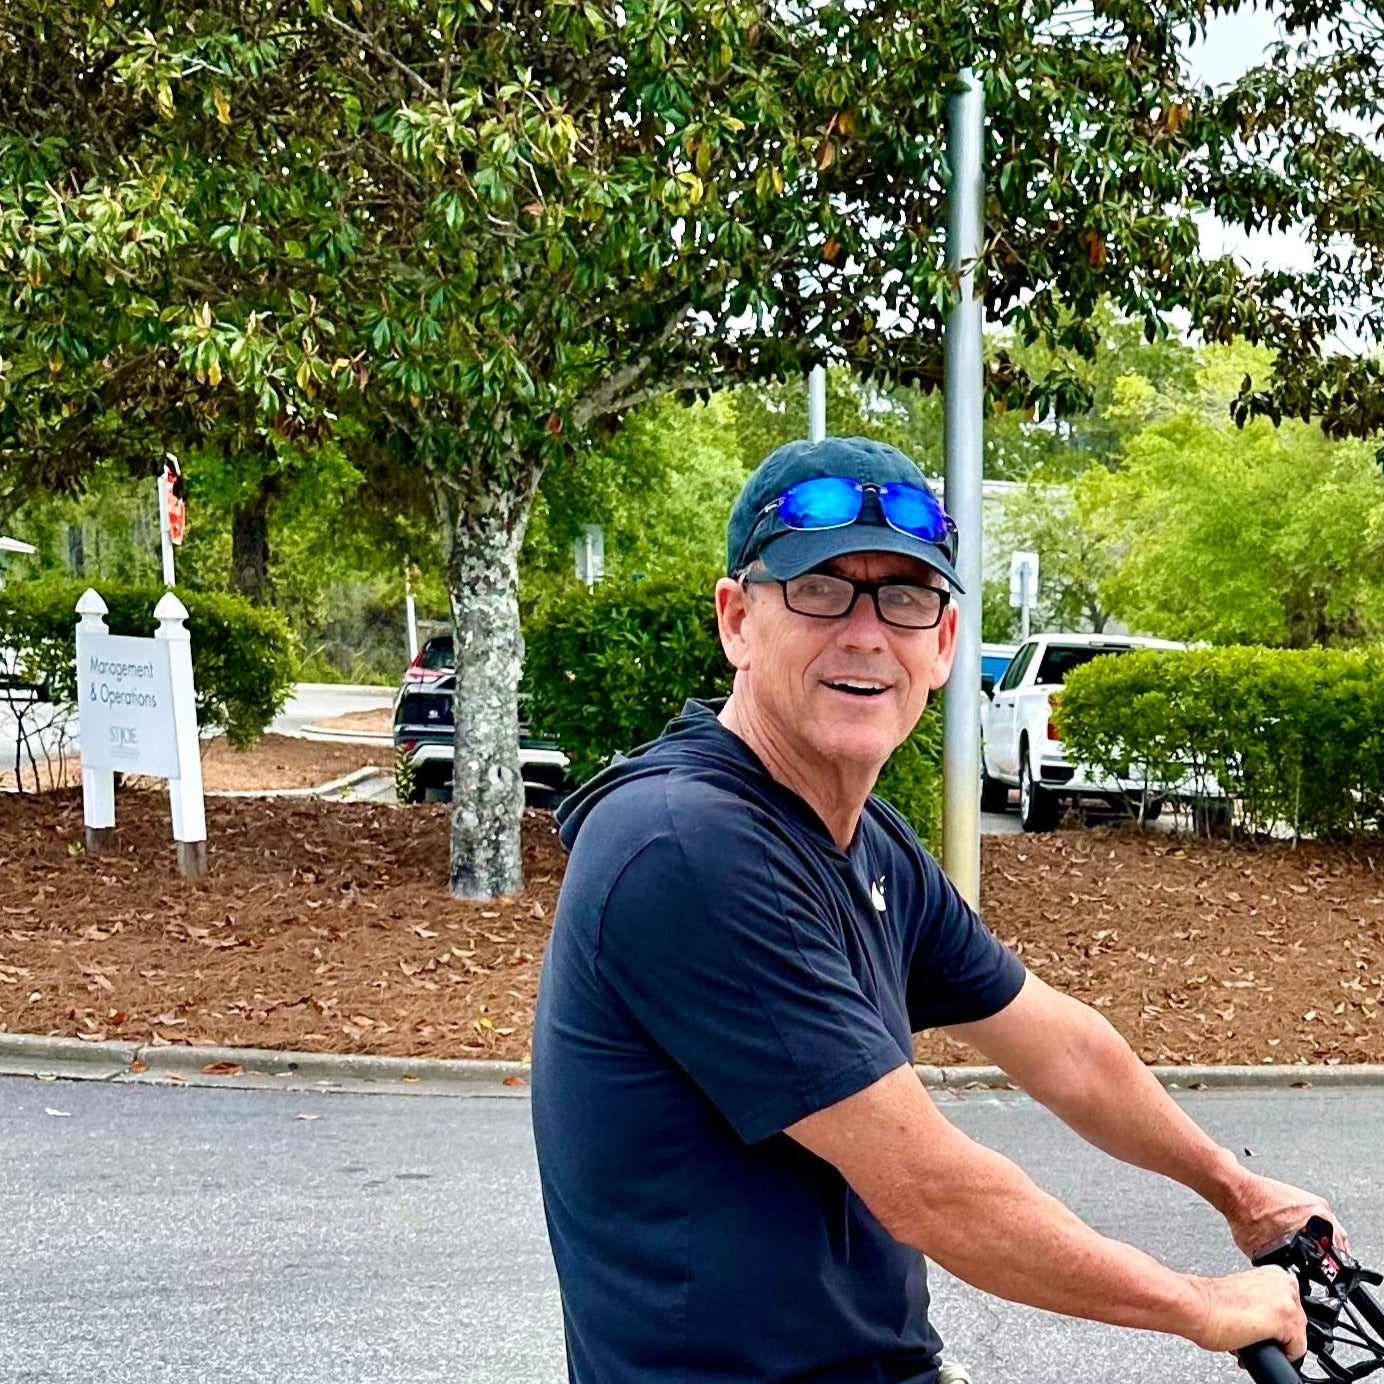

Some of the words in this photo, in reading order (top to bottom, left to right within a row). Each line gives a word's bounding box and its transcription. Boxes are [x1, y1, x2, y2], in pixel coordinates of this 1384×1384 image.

[90, 655, 154, 681] Management
[90, 682, 98, 702] &
[100, 683, 157, 709] Operations
